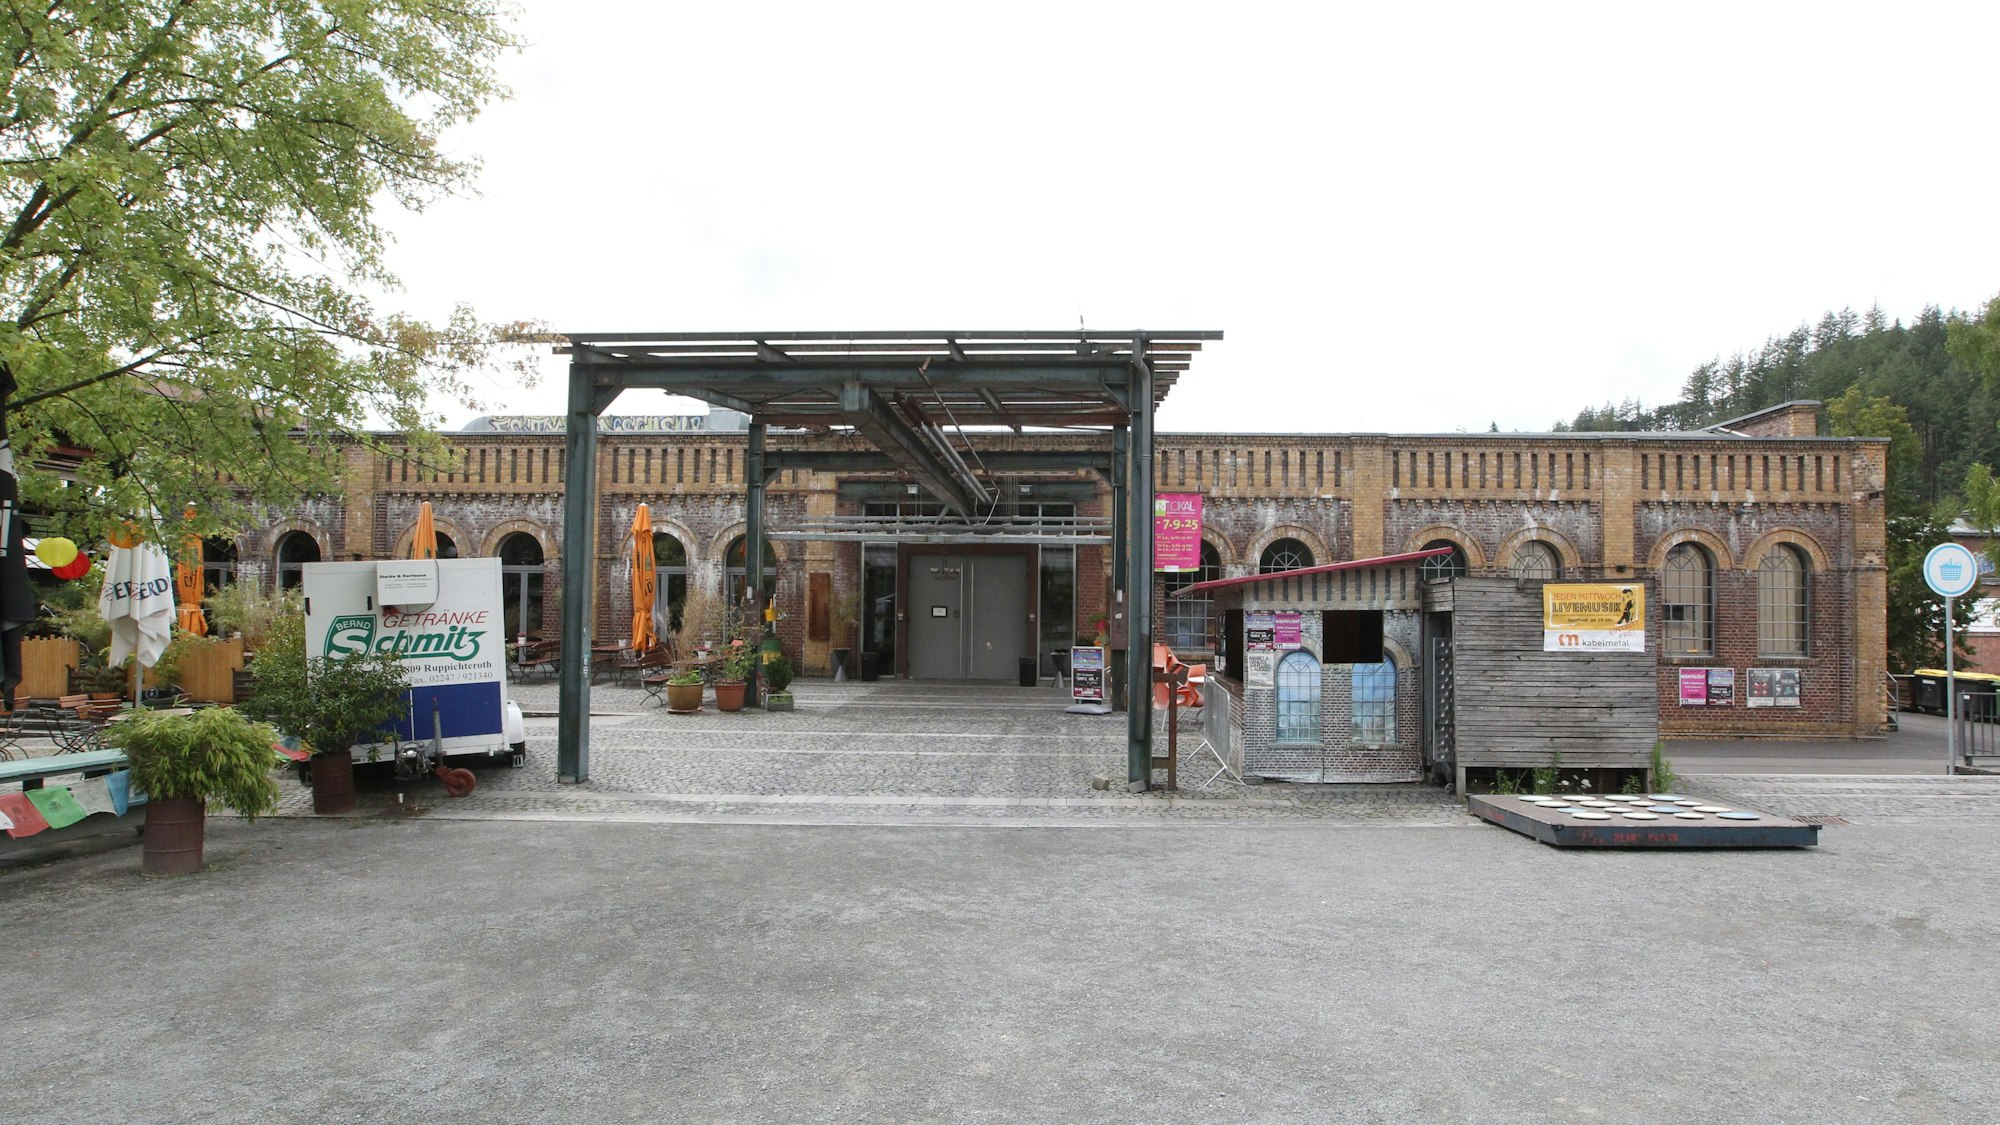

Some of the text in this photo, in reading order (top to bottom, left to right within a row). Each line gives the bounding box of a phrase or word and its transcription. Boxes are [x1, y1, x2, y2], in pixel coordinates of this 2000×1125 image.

[1163, 519, 1198, 530] 7.9.25
[1552, 593, 1620, 601] JEDEN MITTWOCH
[1552, 602, 1622, 613] LIVEMUSIK
[383, 609, 489, 628] GETRÄNKE
[335, 619, 371, 631] BERND
[326, 625, 489, 661] Schmitz
[1582, 639, 1630, 647] kabelmetal
[405, 661, 492, 674] 809 Ruppichteroth
[429, 673, 455, 683] 02247
[463, 672, 493, 680] 921340
